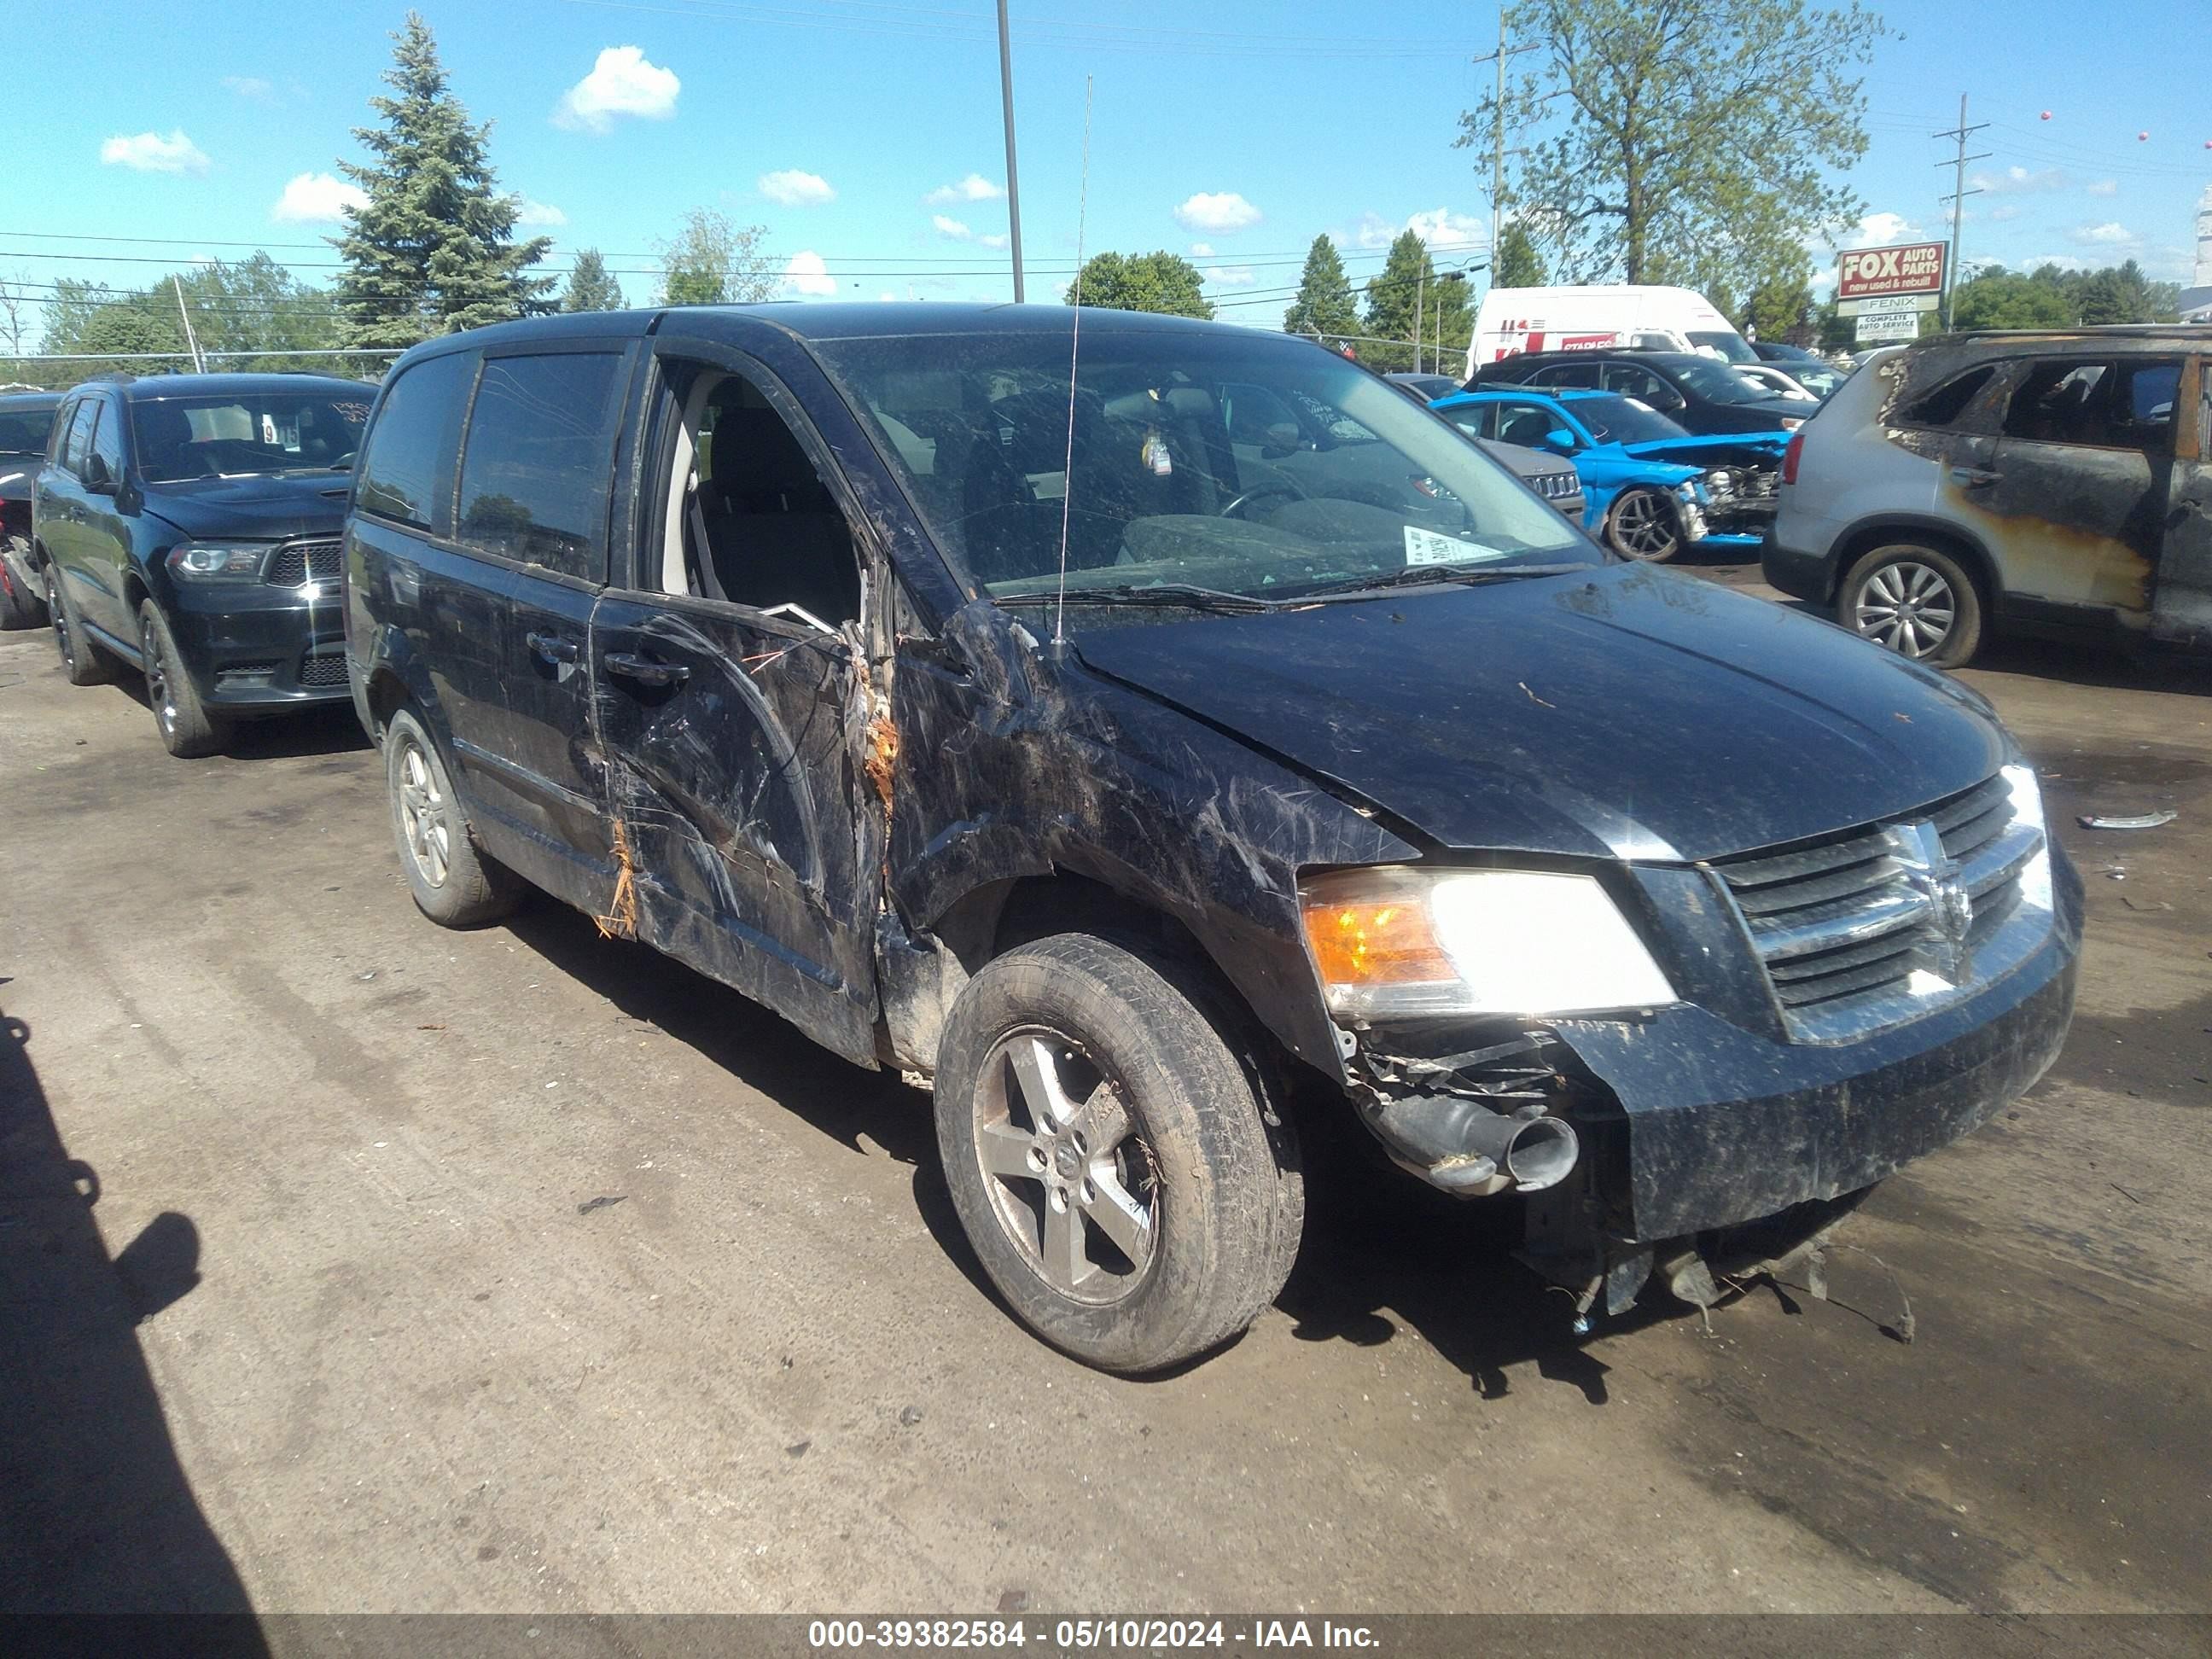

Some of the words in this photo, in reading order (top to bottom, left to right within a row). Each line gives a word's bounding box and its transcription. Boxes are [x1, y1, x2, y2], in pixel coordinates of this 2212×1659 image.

[1903, 247, 1936, 262] AUTO
[1844, 252, 1900, 281] FOX
[1902, 260, 1939, 275] PARTS
[1849, 282, 1868, 291] new
[1869, 279, 1891, 290] used
[1893, 278, 1900, 288] &
[1902, 276, 1930, 287] rebuilt
[1870, 297, 1915, 308] FENIX
